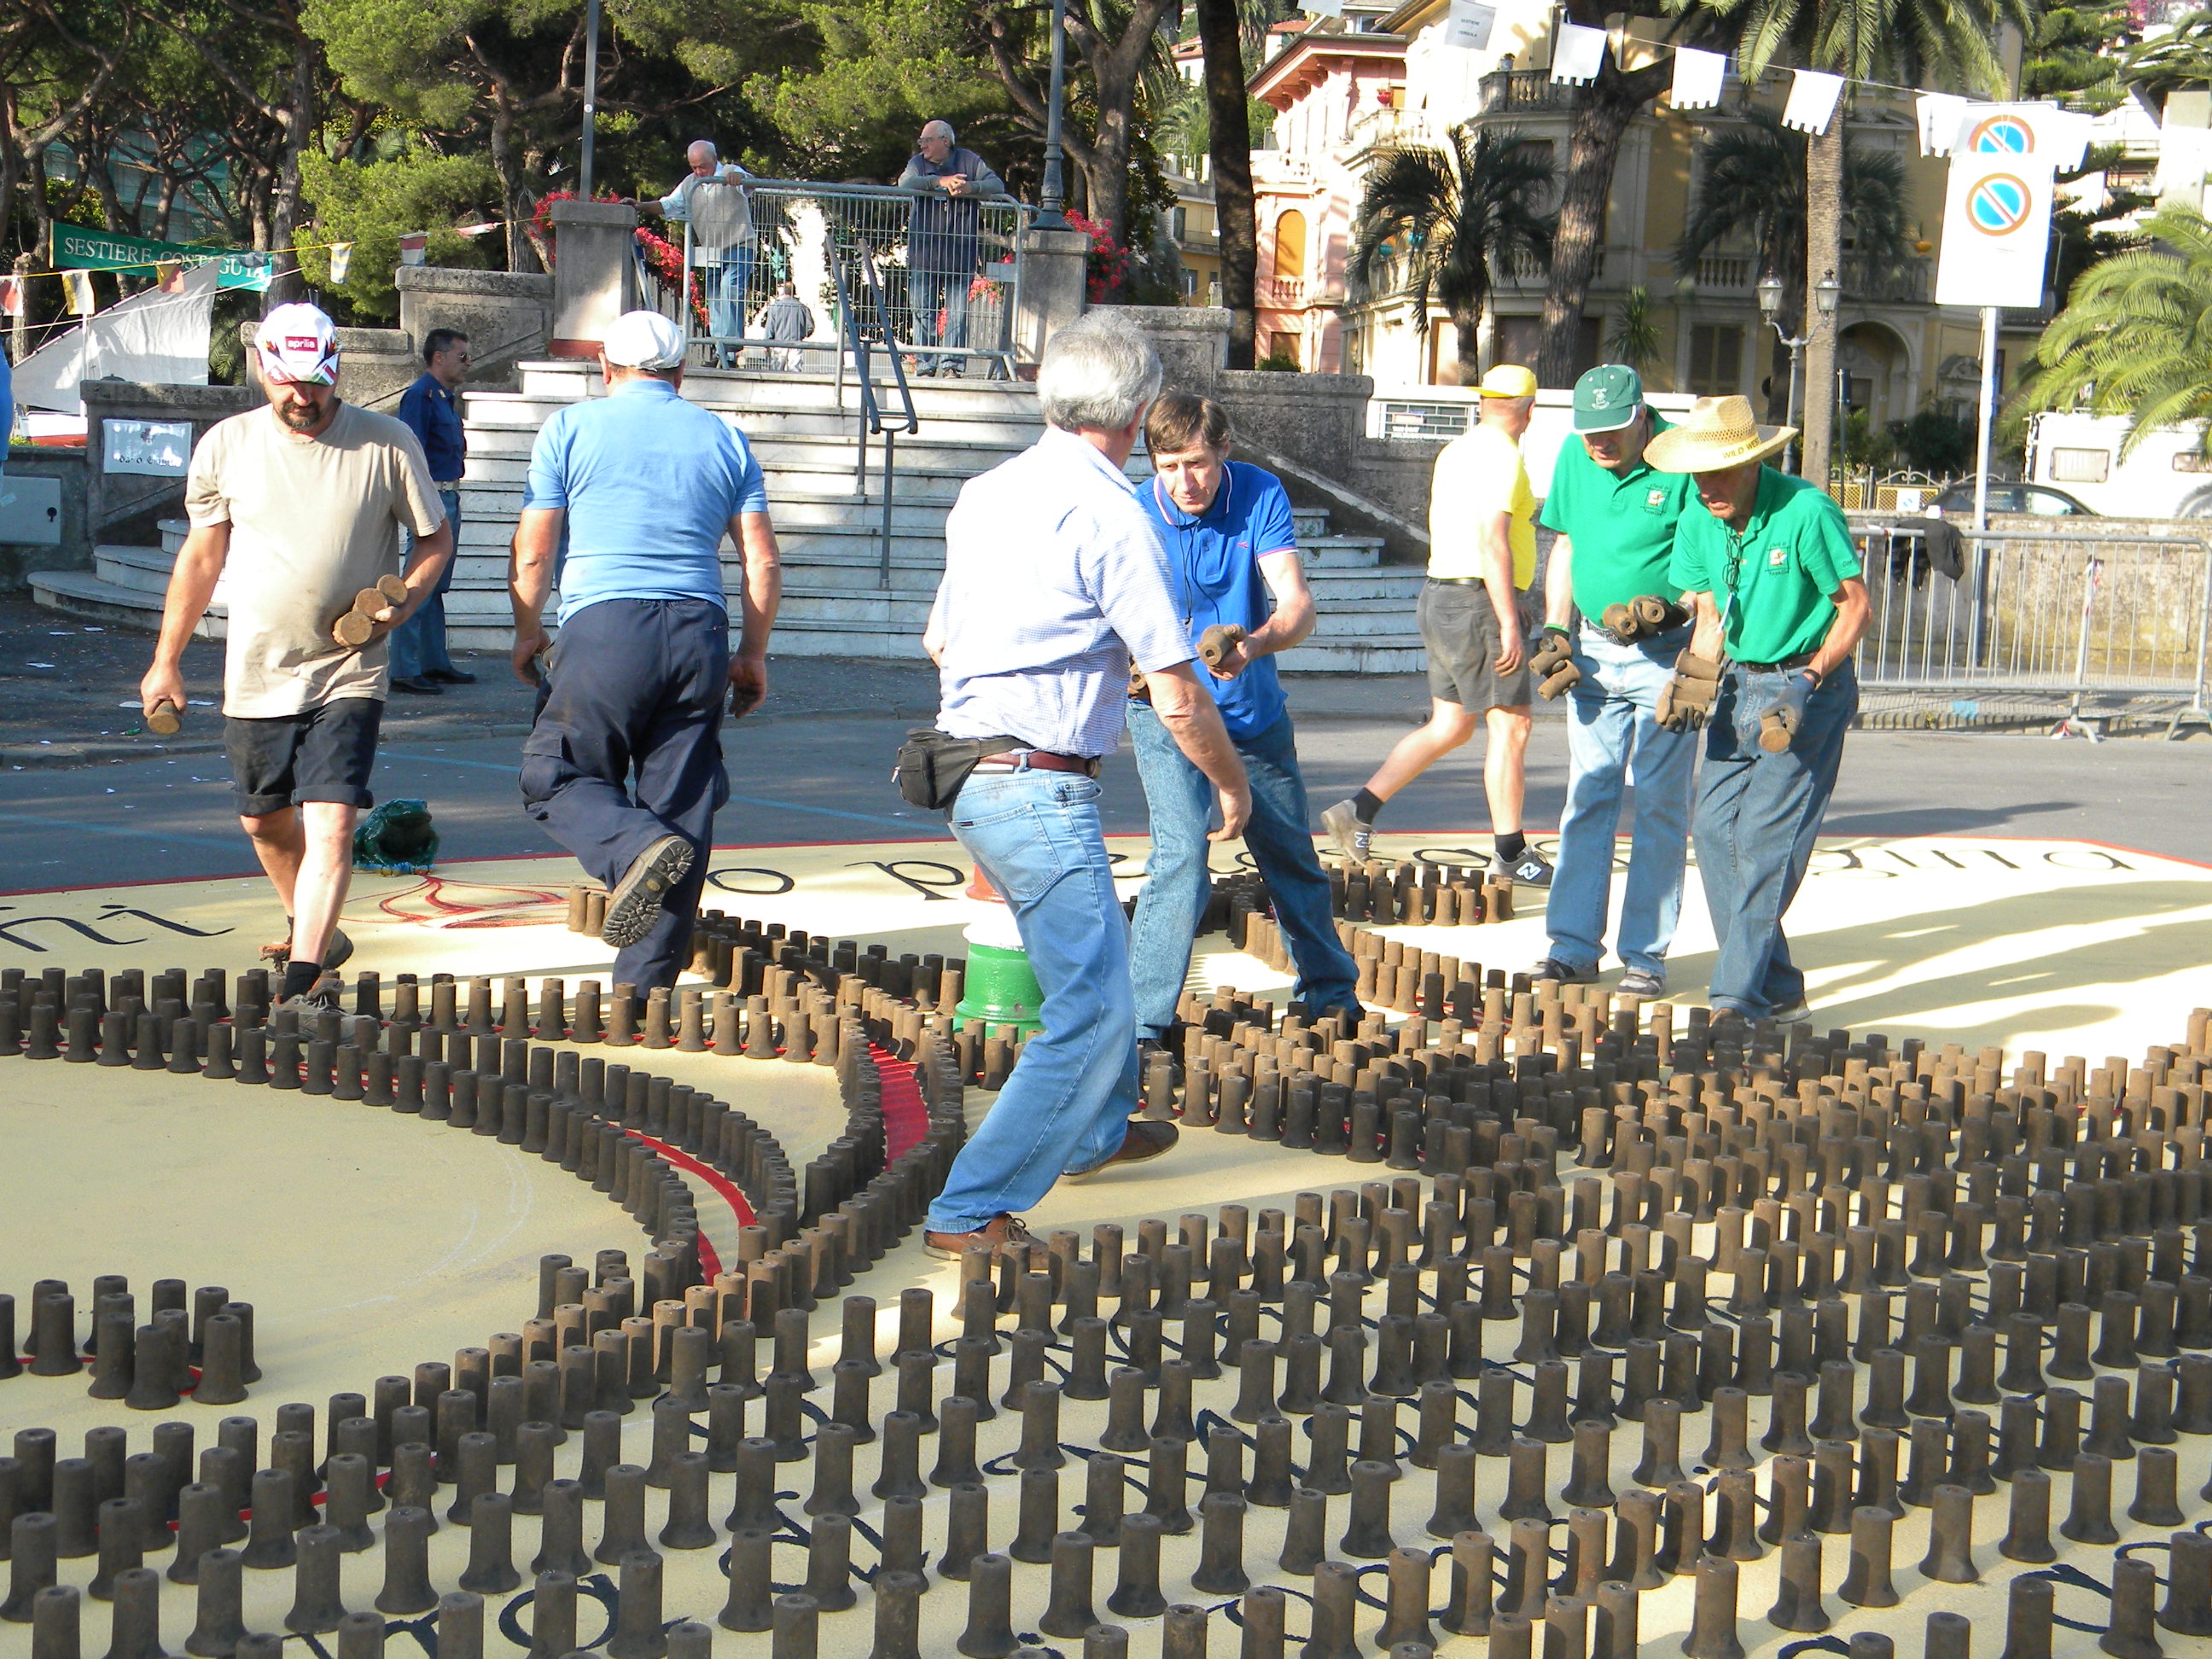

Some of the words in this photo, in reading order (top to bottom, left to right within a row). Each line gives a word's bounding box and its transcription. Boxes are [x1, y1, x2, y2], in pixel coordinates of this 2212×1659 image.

[64, 236, 153, 264] SESTIERE
[160, 250, 266, 278] COSTGUA
[1722, 446, 1744, 458] WILD
